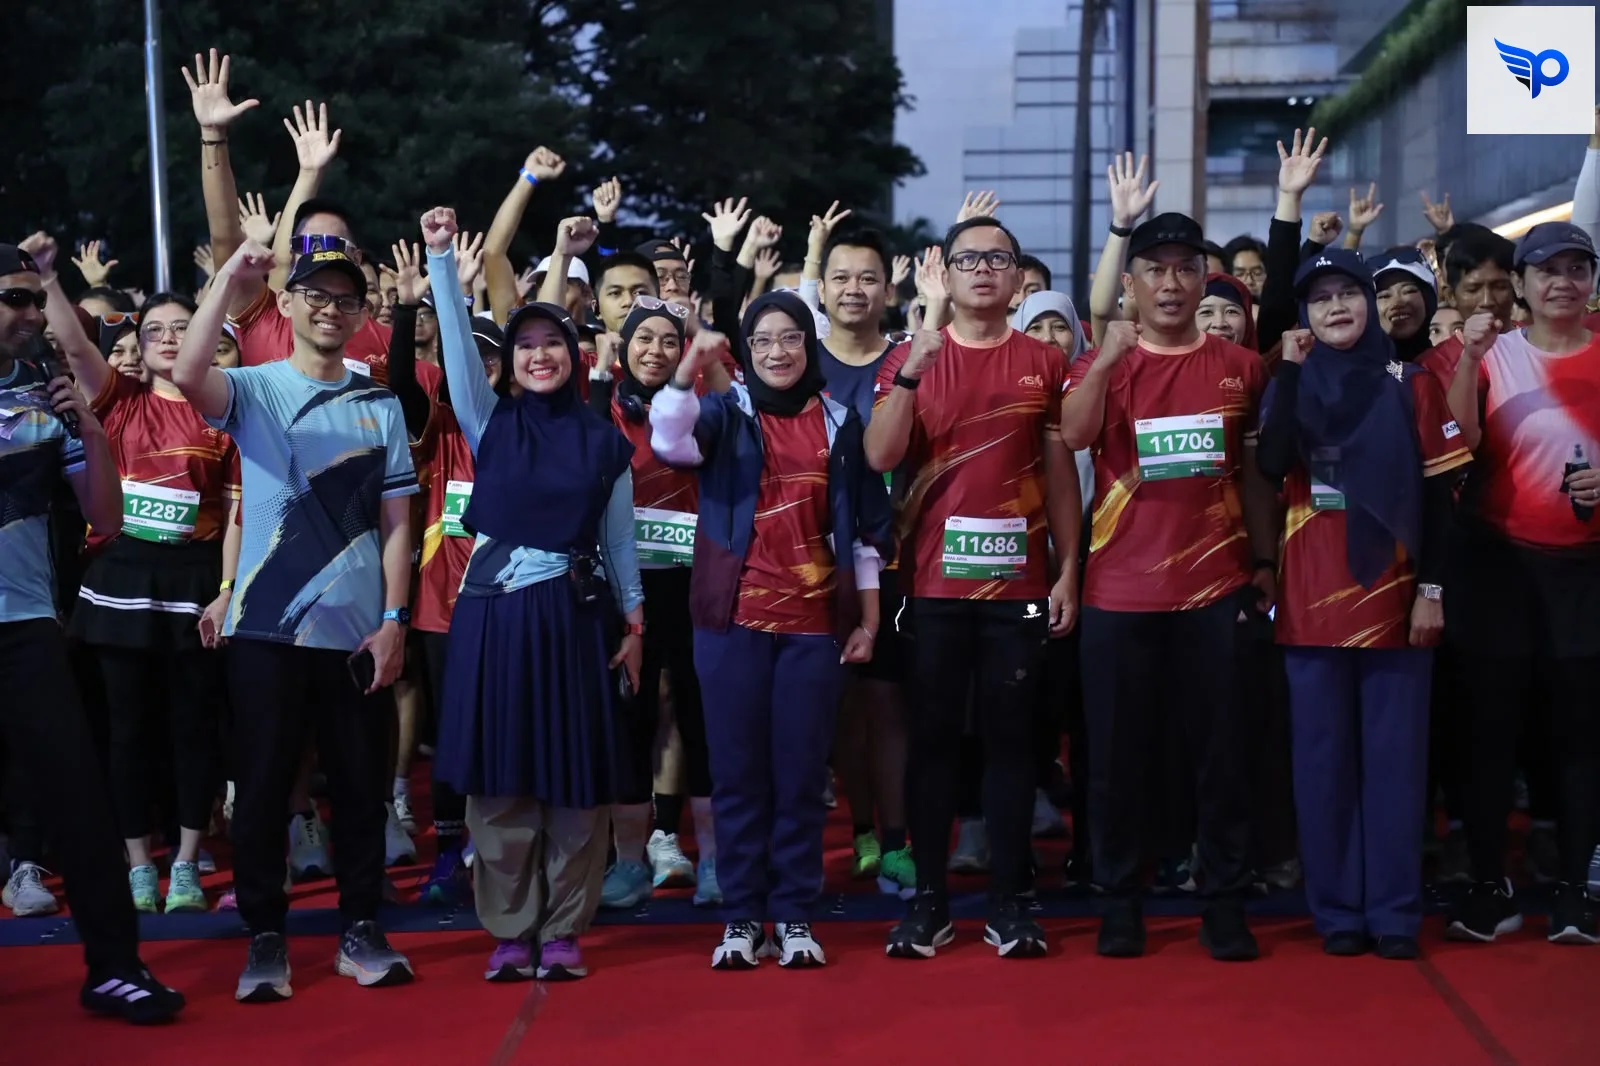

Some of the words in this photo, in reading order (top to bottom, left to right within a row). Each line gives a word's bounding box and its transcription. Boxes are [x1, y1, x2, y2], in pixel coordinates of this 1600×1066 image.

[1150, 432, 1215, 453] 11706
[129, 498, 189, 521] 12287
[641, 524, 695, 545] 12209
[956, 535, 1018, 554] 11686
